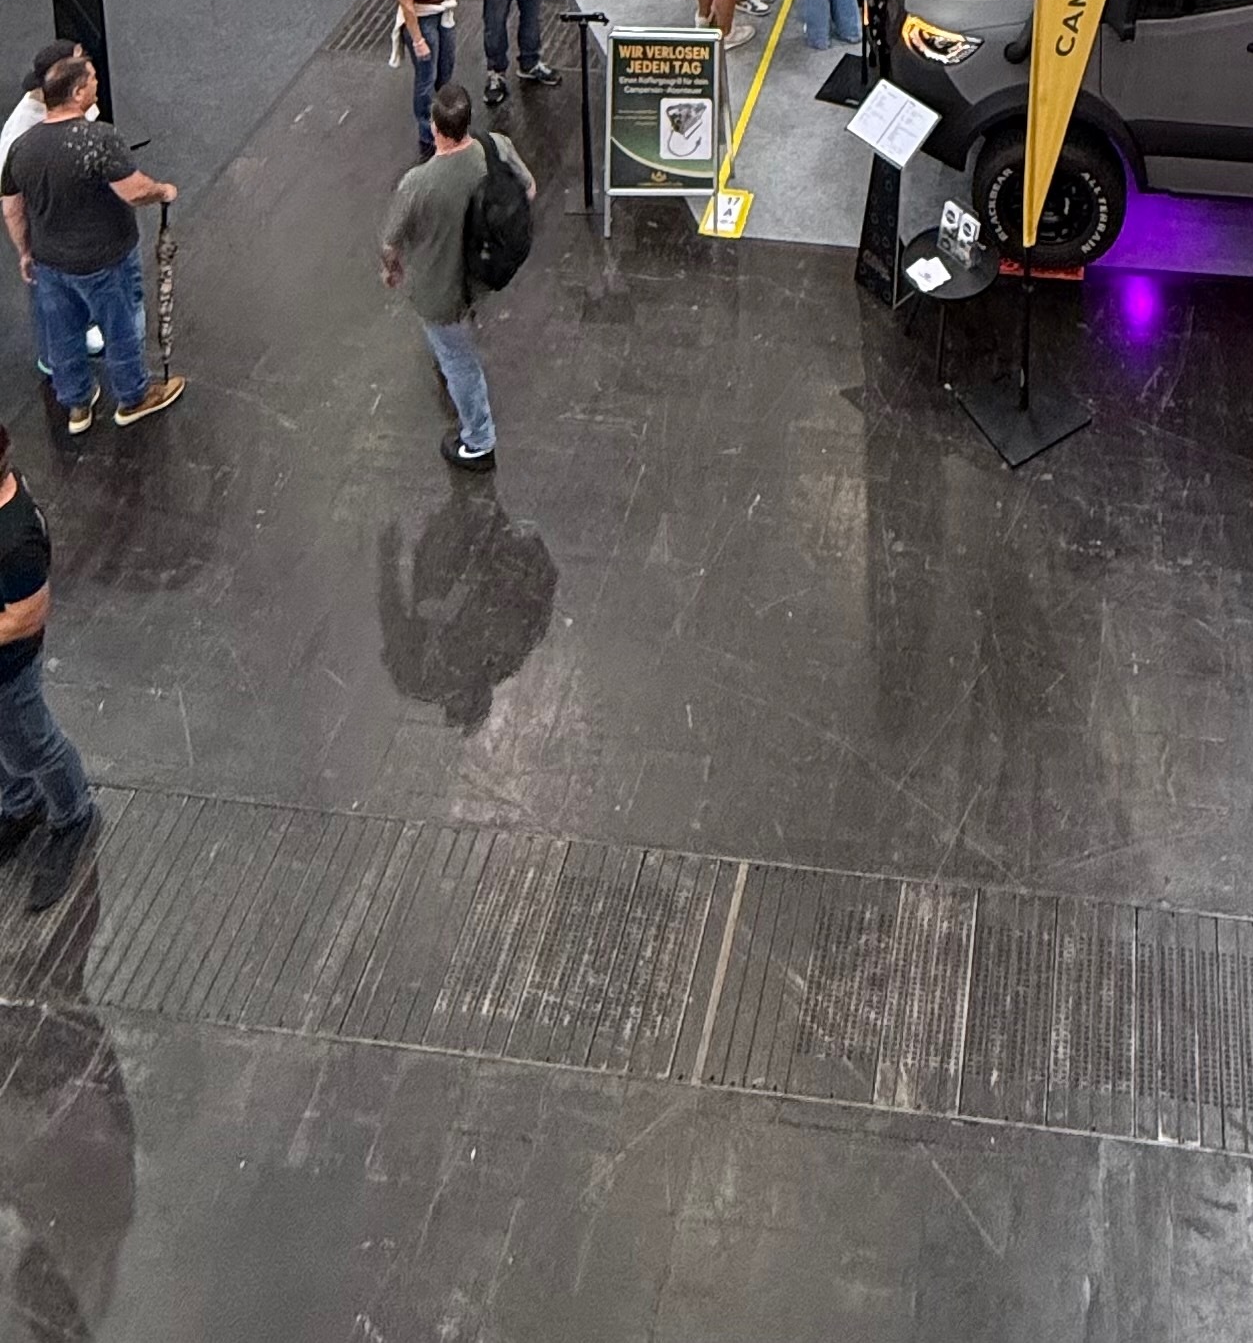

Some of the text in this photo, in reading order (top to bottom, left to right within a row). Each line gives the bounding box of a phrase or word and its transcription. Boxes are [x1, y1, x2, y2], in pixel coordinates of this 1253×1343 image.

[618, 44, 710, 60] WIR VERLOSEN
[626, 60, 702, 75] JEDEN TAG
[987, 167, 1014, 243] BLACKBEAR
[1080, 171, 1109, 255] ALL TERRAIN
